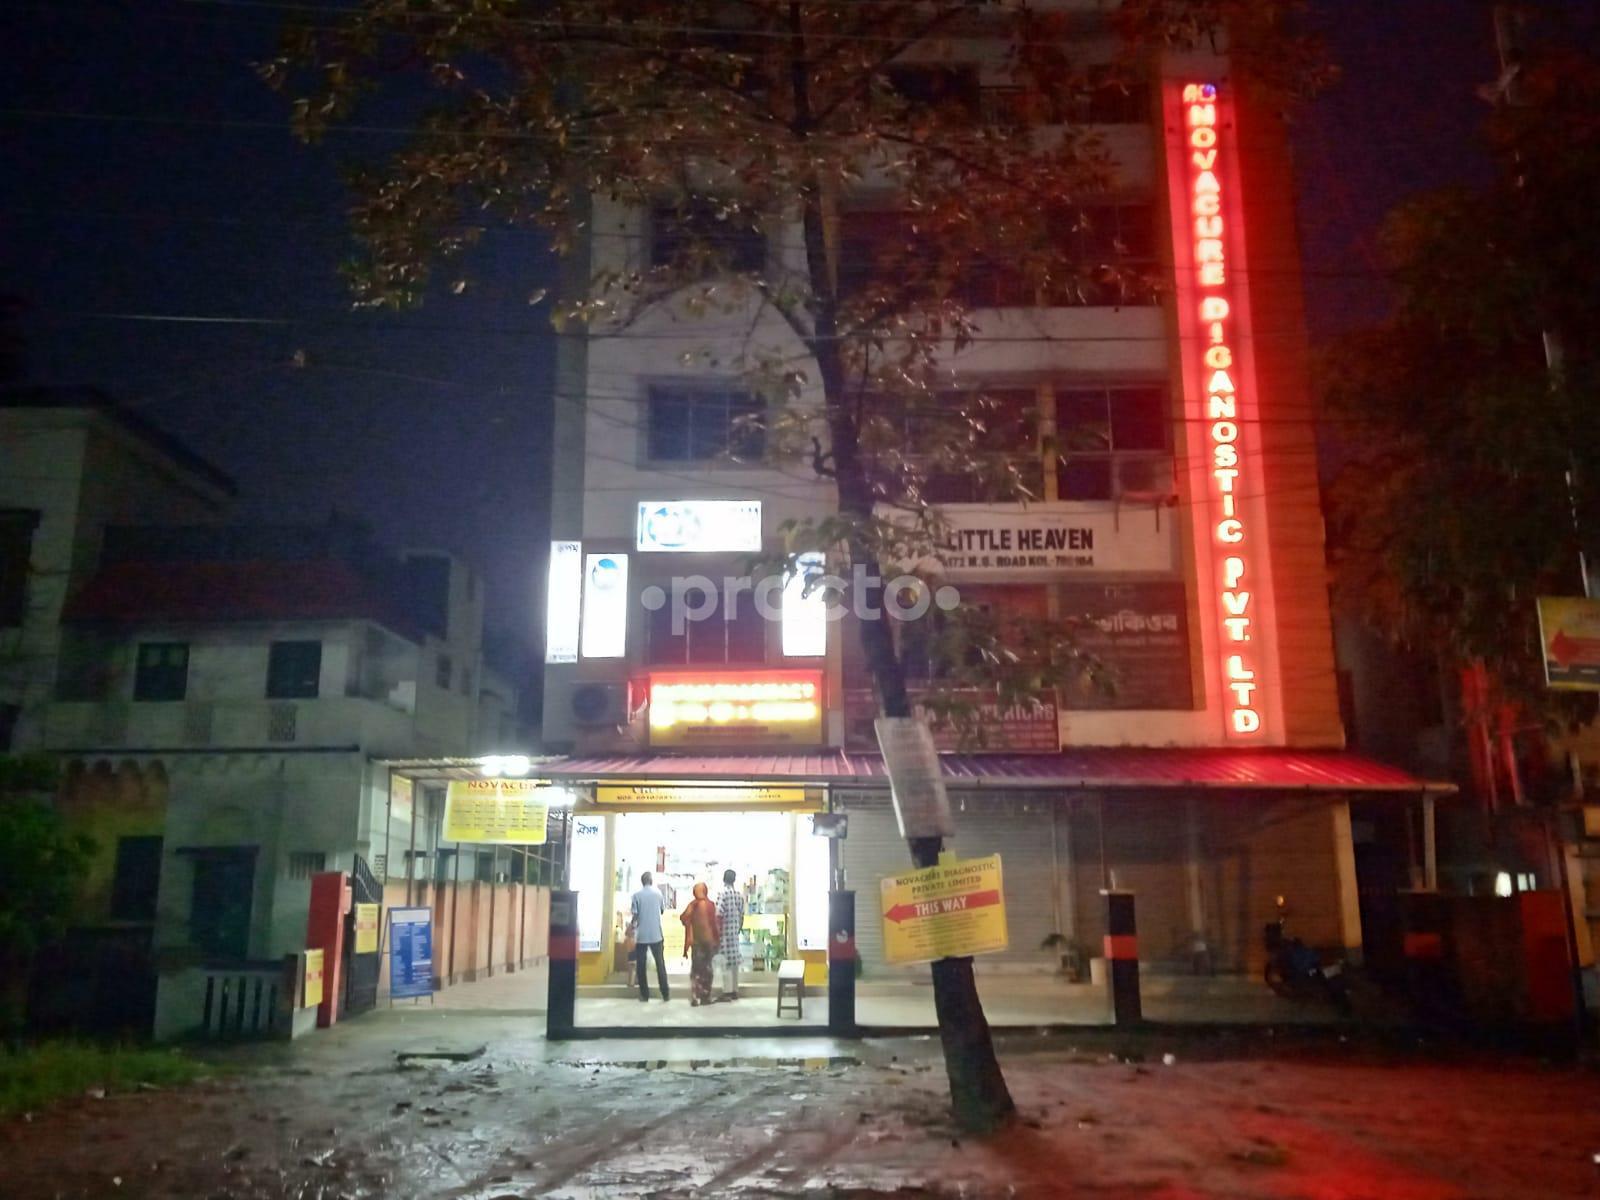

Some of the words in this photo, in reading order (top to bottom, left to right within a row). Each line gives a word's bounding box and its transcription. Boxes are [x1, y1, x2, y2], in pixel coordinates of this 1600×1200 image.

[1201, 296, 1244, 543] DIGANOSTIC
[1228, 655, 1260, 733] LTD
[946, 528, 1012, 551] LITTLE
[1018, 528, 1093, 550] HEAVEN
[996, 555, 1026, 568] ROAD
[943, 862, 995, 878] DIAGNOSTIC
[912, 882, 945, 893] PRIVATE
[947, 875, 981, 887] LIMITED
[915, 902, 939, 917] THIS
[941, 896, 968, 913] WAY
